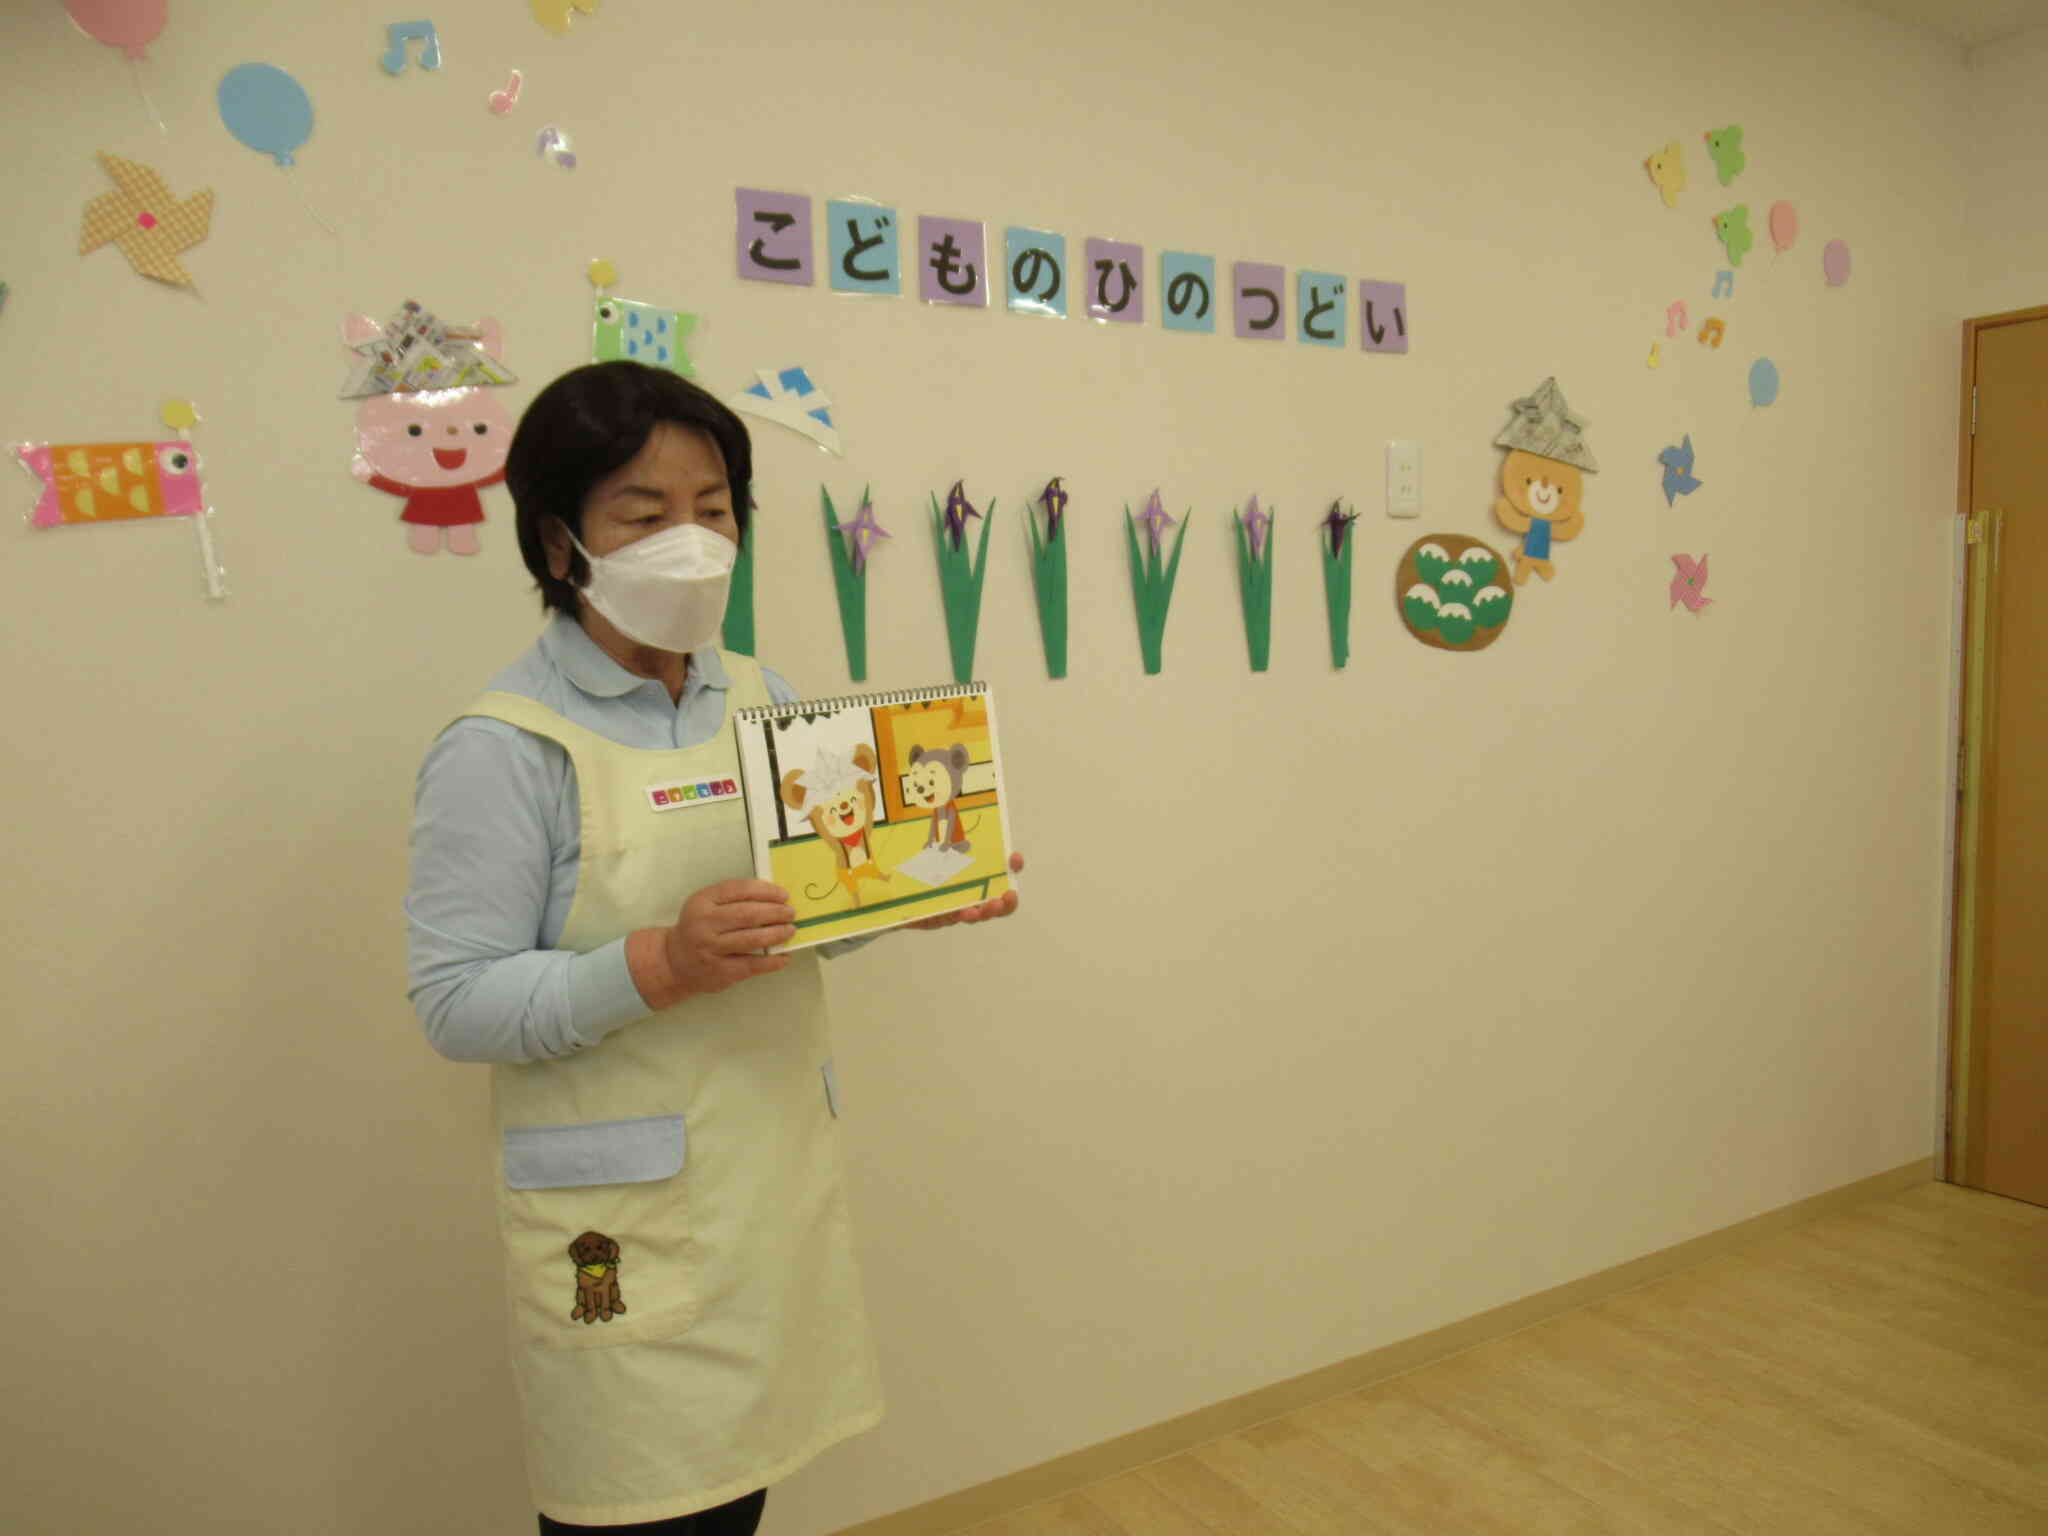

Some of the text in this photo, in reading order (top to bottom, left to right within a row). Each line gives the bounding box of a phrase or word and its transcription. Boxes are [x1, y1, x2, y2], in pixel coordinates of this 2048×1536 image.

[748, 210, 1405, 343] こどものひのつどい
